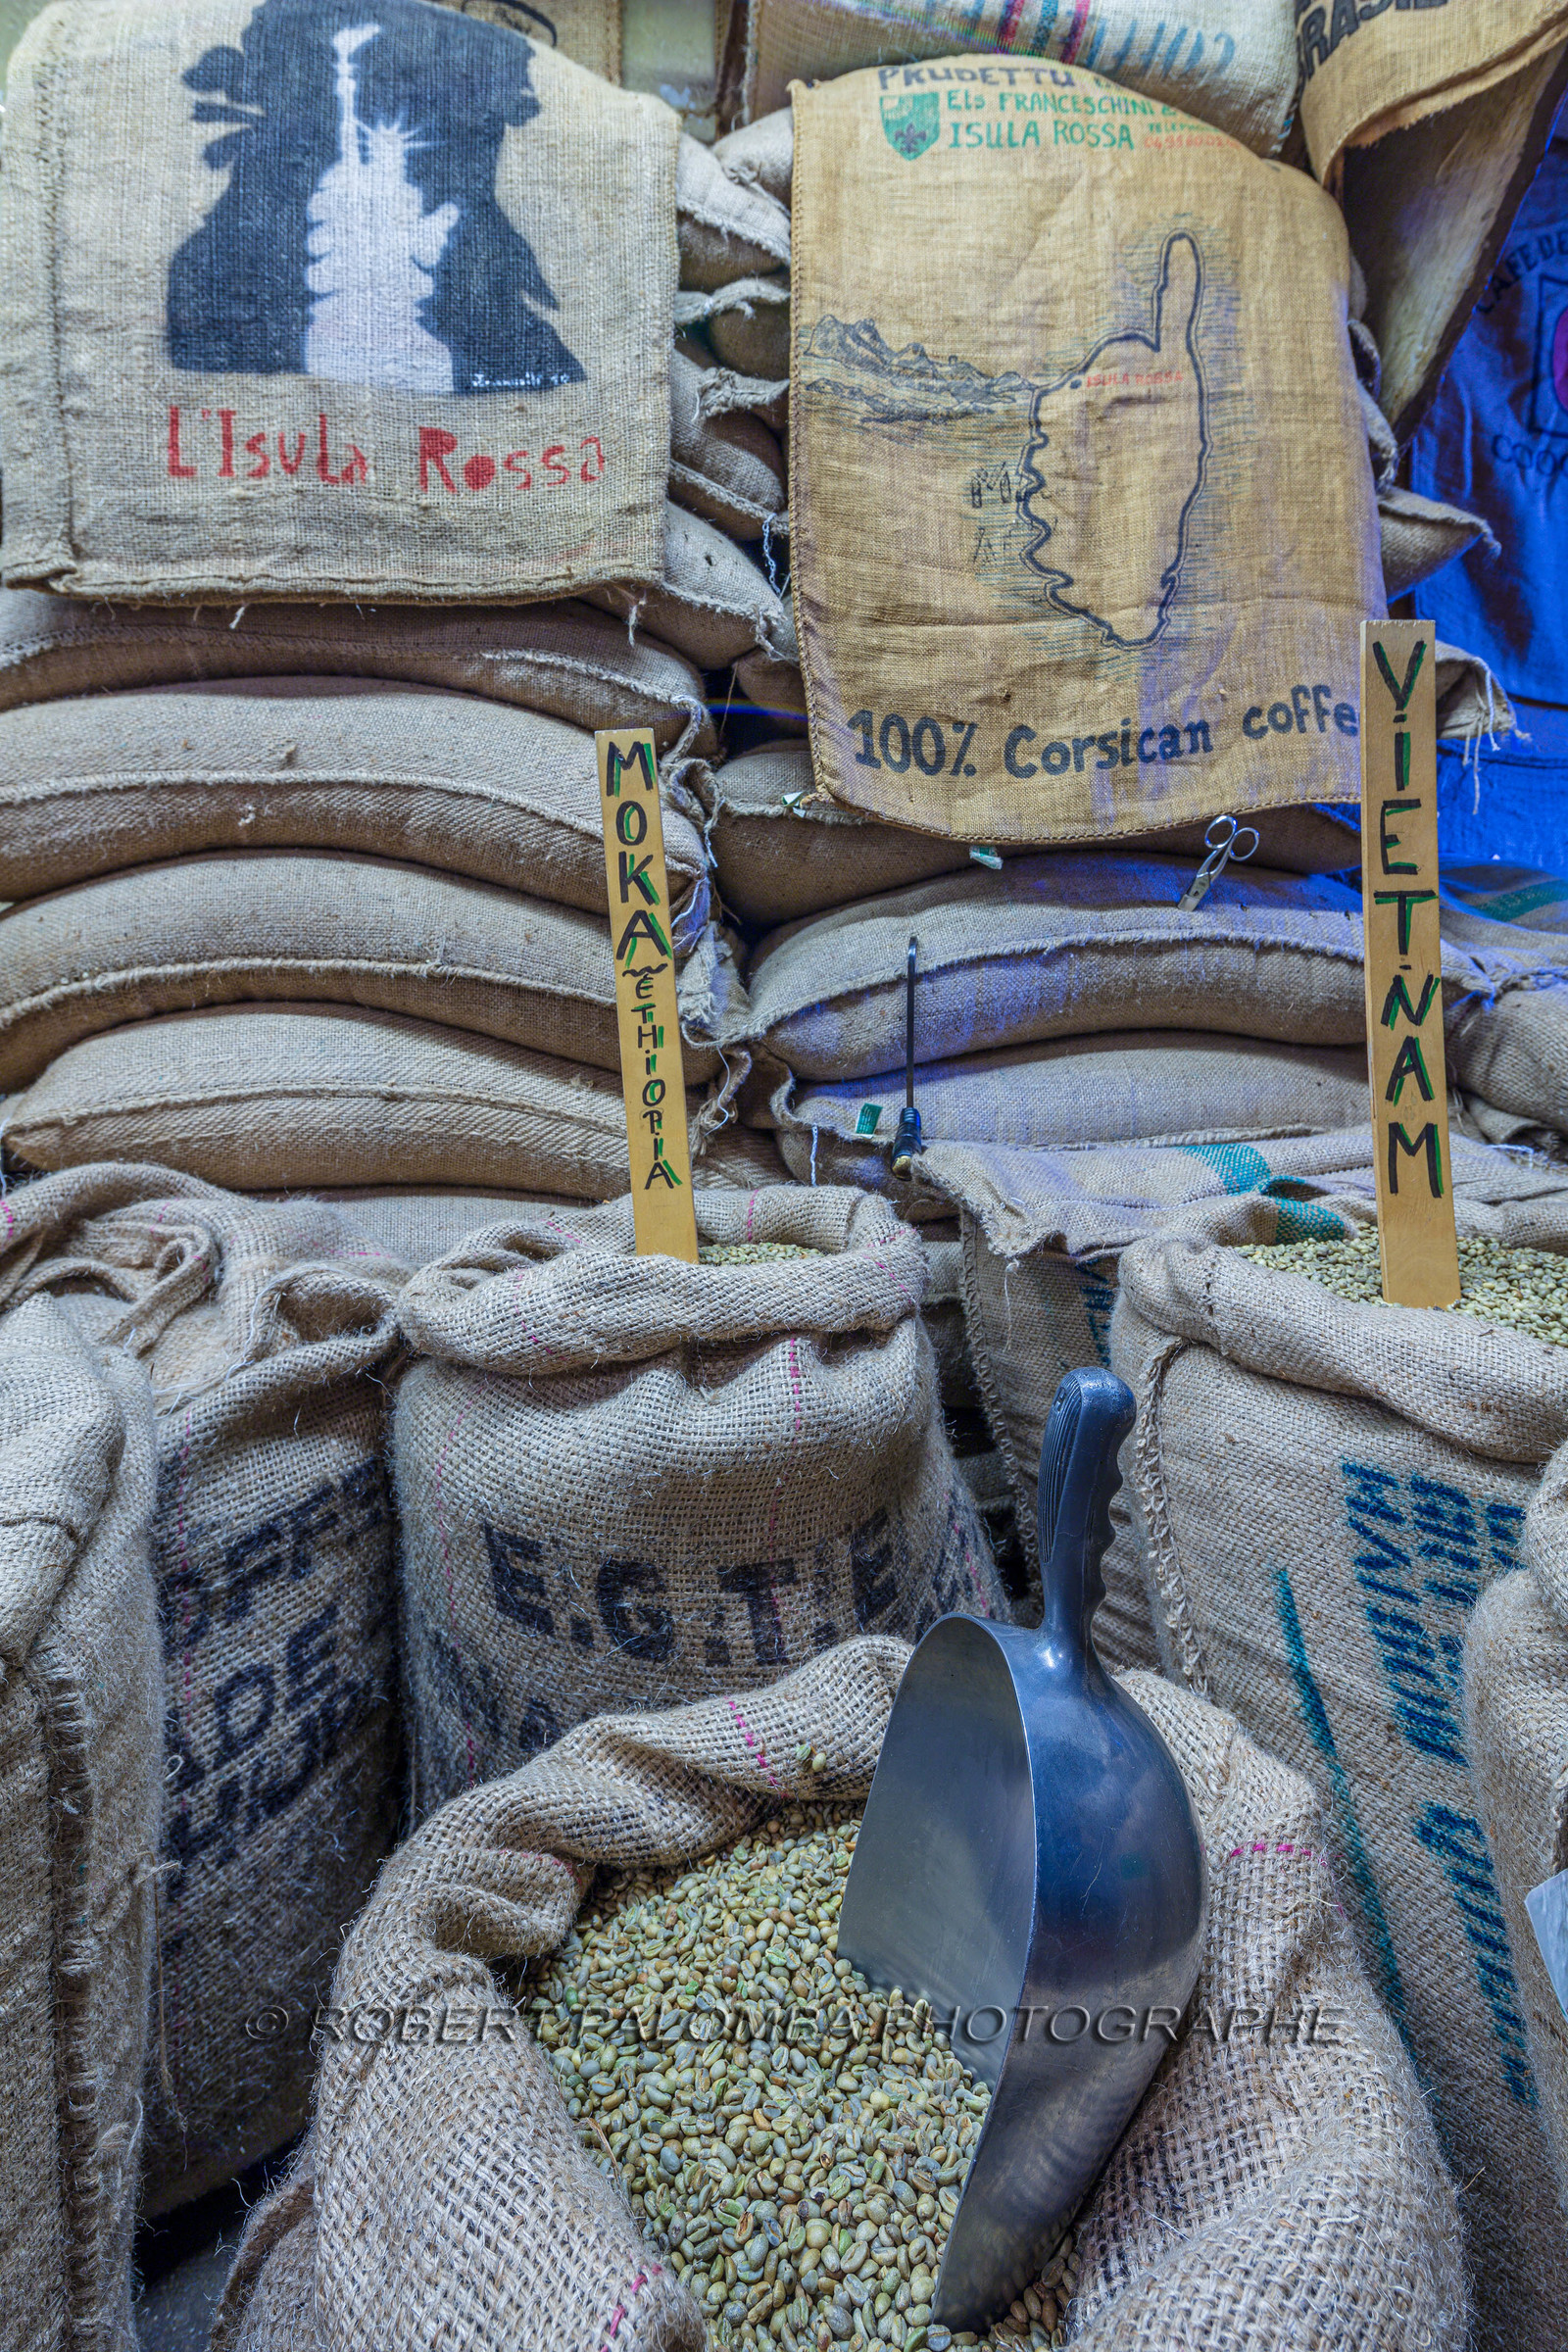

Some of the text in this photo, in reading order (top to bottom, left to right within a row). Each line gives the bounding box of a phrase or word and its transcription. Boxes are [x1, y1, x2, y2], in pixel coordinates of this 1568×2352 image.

[999, 91, 1155, 117] FRANCESCHINI
[949, 119, 1135, 150] ISULA ROSSA
[1086, 369, 1184, 389] ISULA ROSSA
[418, 425, 606, 494] Rossa
[846, 708, 979, 778] 100%
[1004, 716, 1213, 779] Corsican
[606, 740, 673, 968] MOKA
